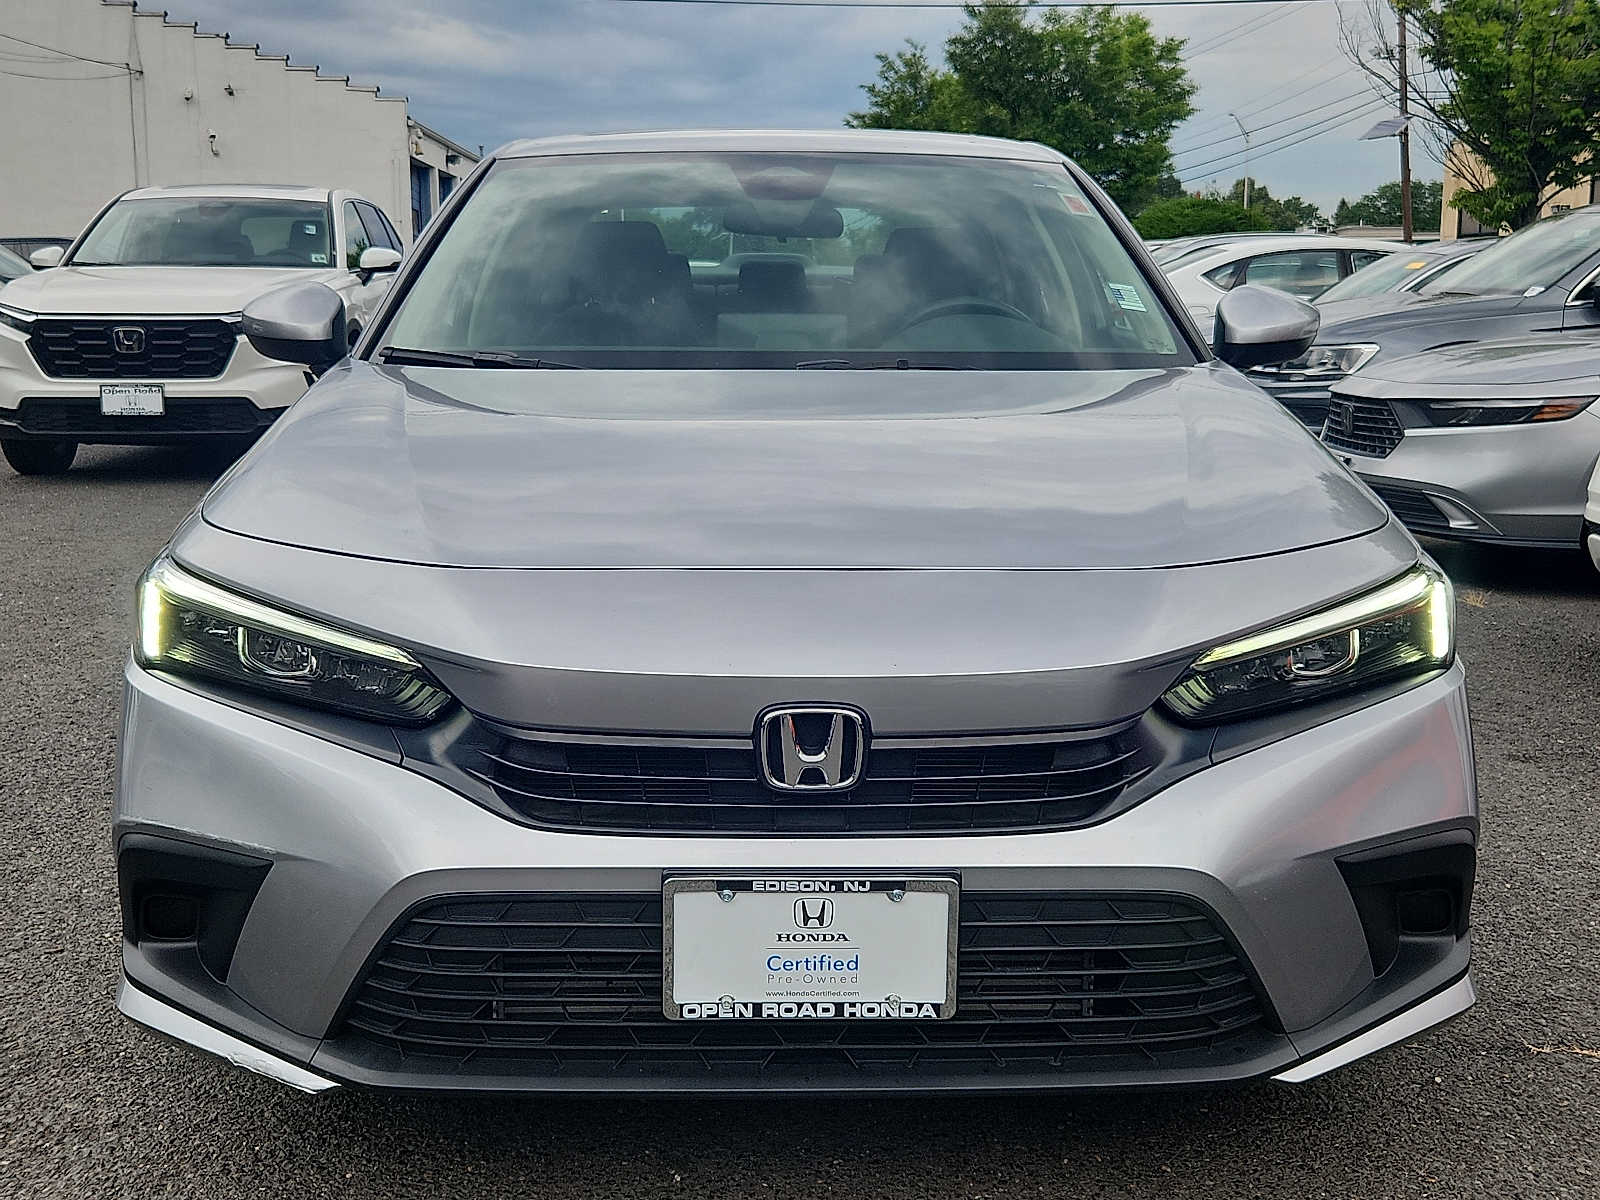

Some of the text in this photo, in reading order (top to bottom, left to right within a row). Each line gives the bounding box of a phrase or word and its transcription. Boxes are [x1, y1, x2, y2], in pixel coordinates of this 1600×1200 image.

[752, 880, 871, 892] EDISON, NJ
[775, 932, 850, 942] HONDA
[766, 954, 859, 972] Certified
[767, 973, 858, 984] Pre-Owned
[682, 1003, 937, 1019] OPEN ROAD HONDA
